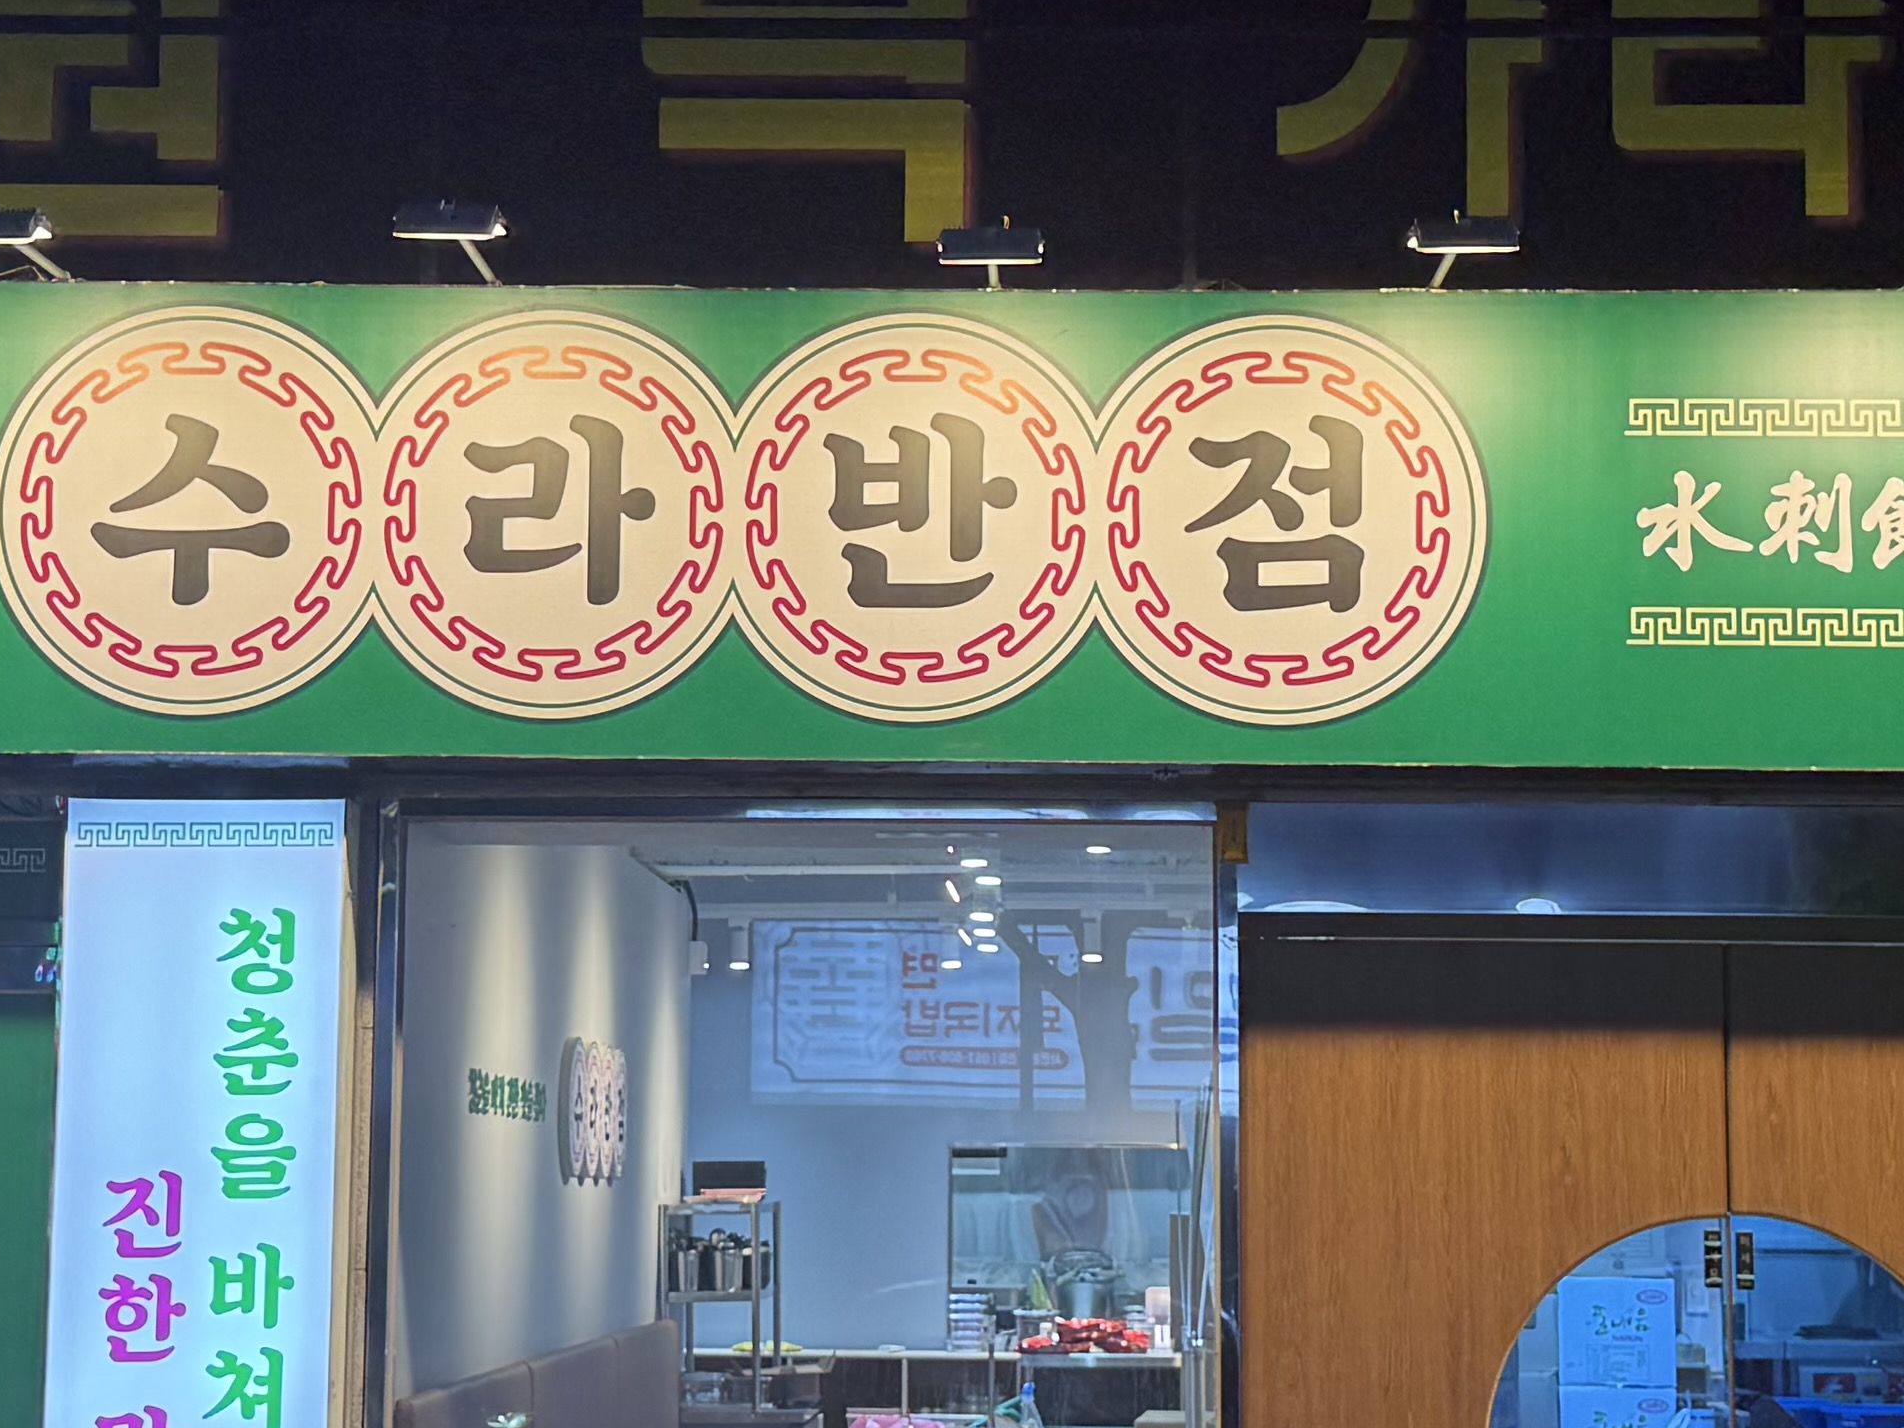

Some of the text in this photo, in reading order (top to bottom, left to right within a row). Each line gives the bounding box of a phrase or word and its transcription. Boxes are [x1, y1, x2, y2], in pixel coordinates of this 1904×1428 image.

[91, 412, 1366, 614] 수라반점
[209, 906, 300, 1202] 청춘을
[97, 1168, 188, 1366] 진한
